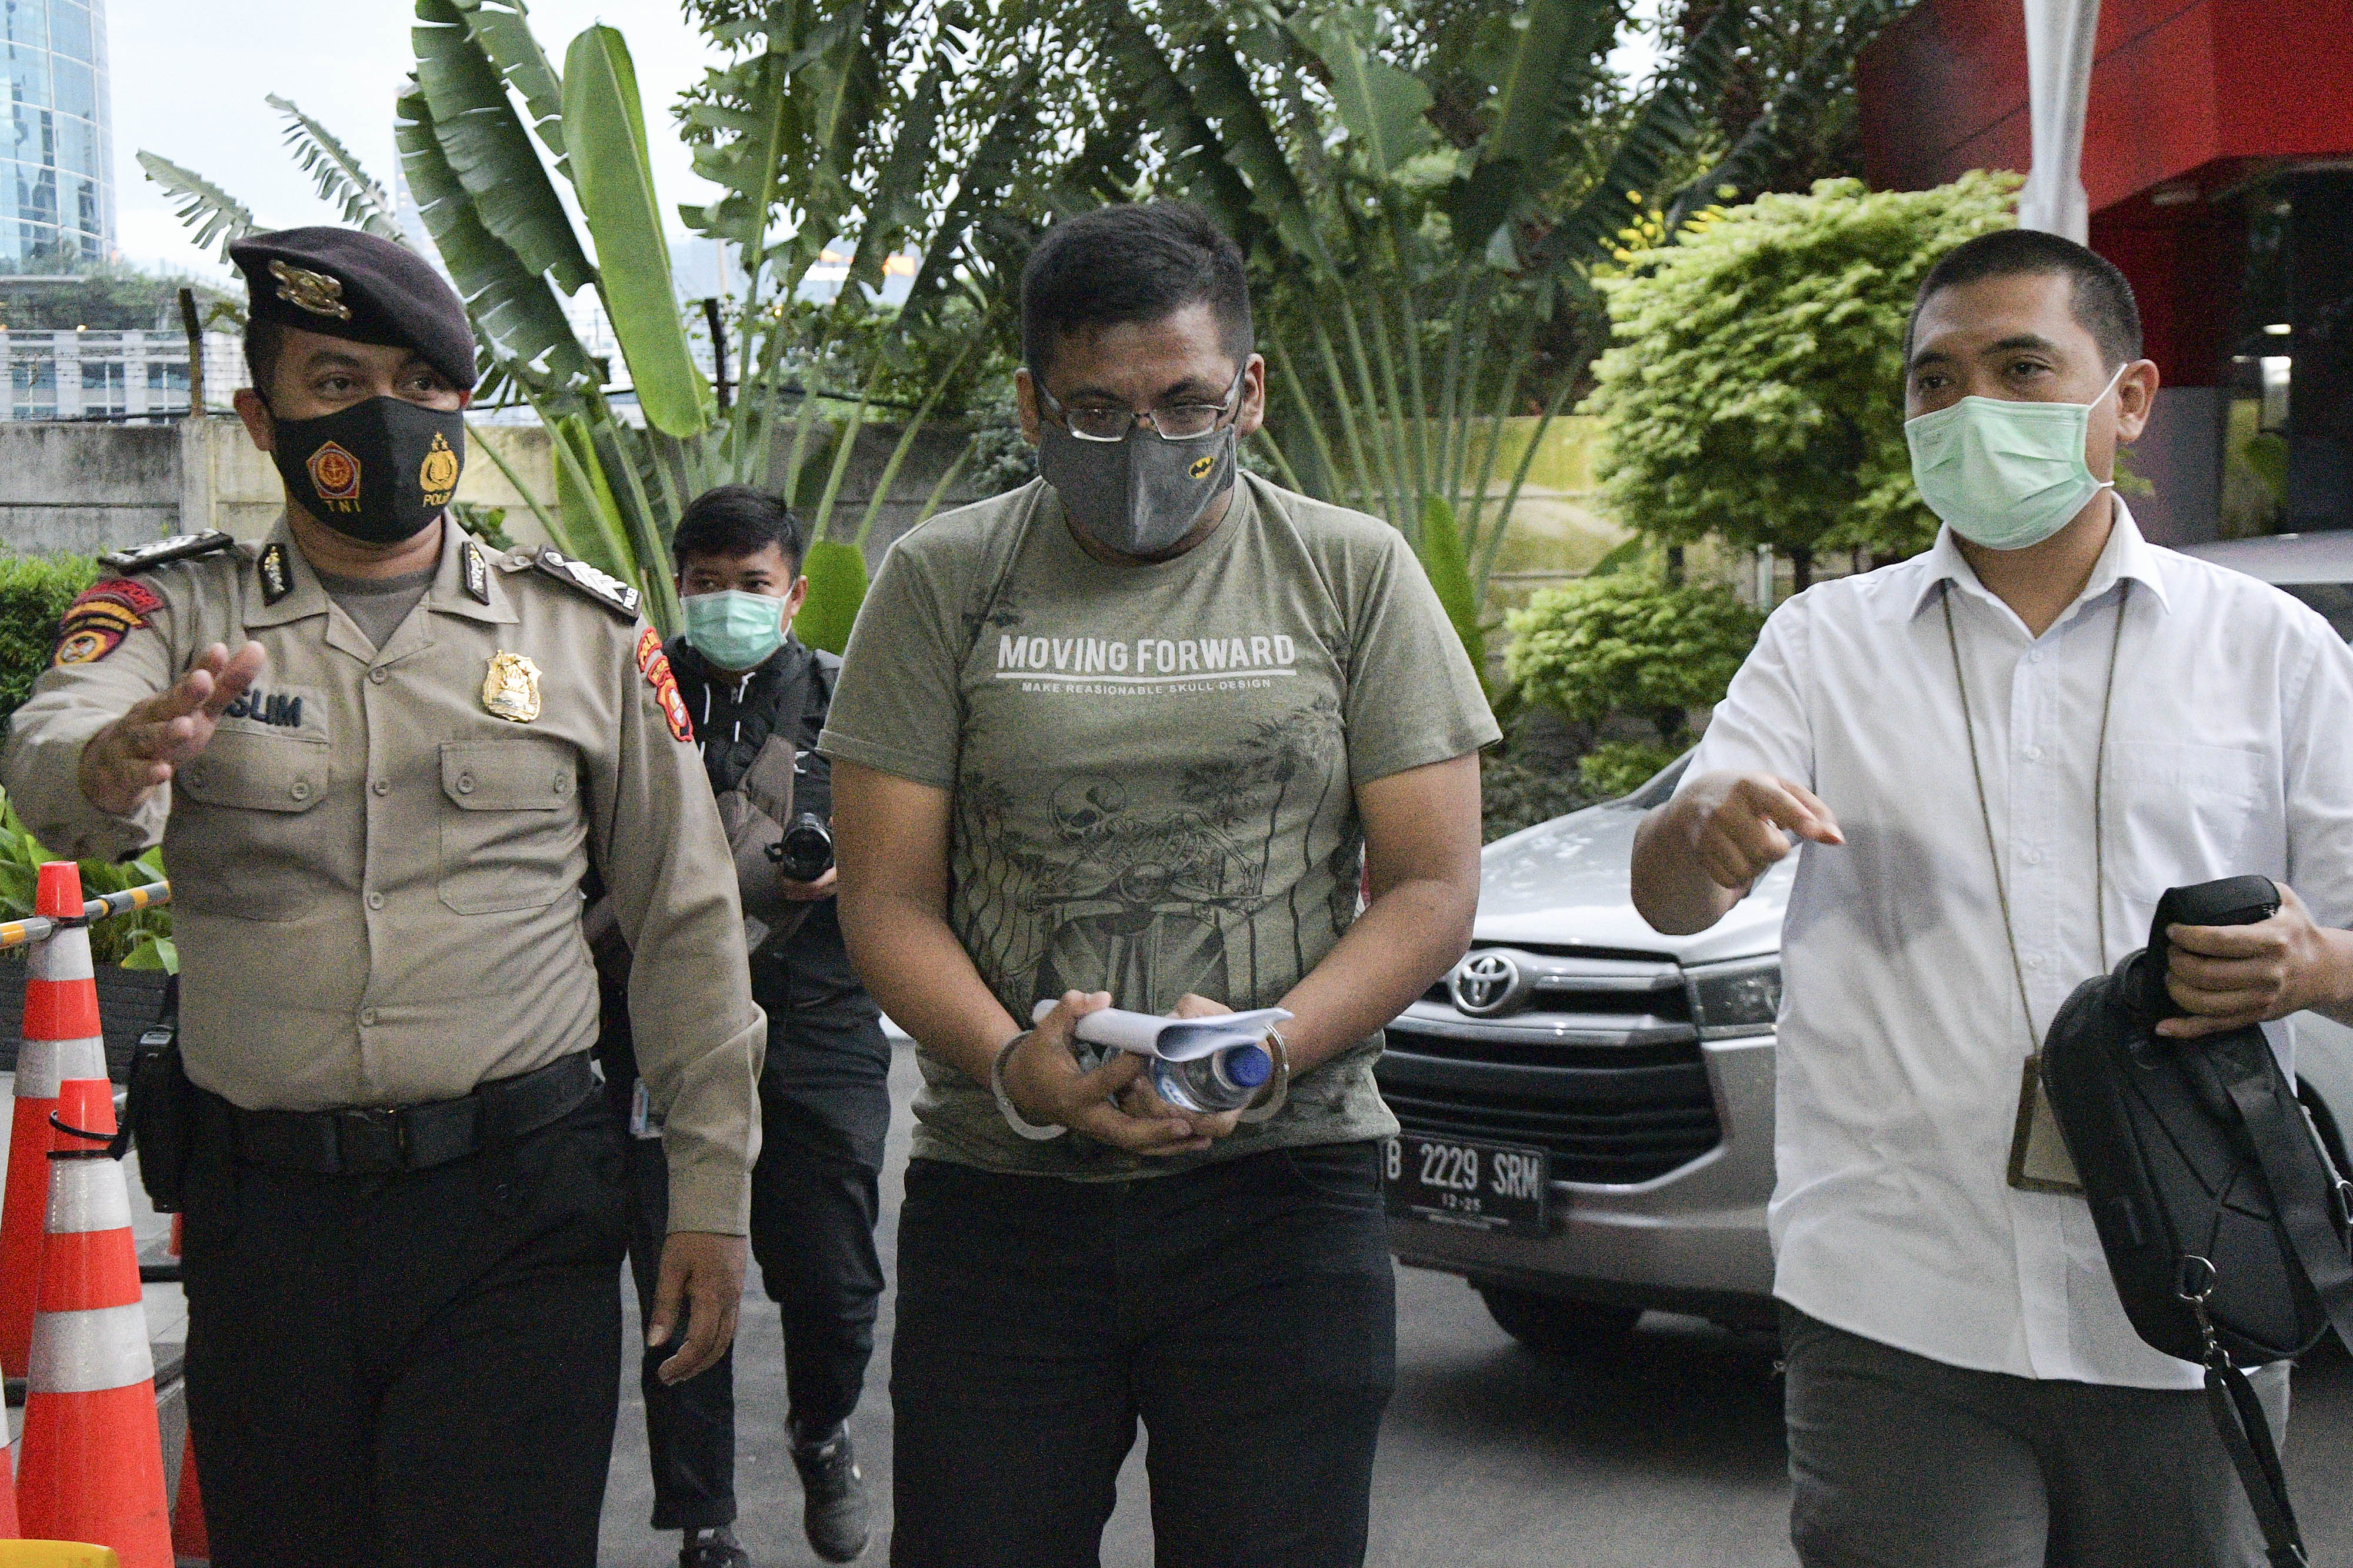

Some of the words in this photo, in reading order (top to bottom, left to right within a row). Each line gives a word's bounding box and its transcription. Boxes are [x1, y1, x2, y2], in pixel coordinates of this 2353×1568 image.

[998, 635, 1128, 673] MOVING
[1137, 635, 1295, 673] FORWARD
[1022, 682, 1059, 693] MAKE
[1066, 684, 1163, 695] REASIONABLE
[1169, 683, 1214, 693] SKULL
[1219, 679, 1271, 690] DESIGN
[1387, 1140, 1402, 1180] B
[1420, 1143, 1478, 1190] 2229
[1492, 1153, 1539, 1200] SRM
